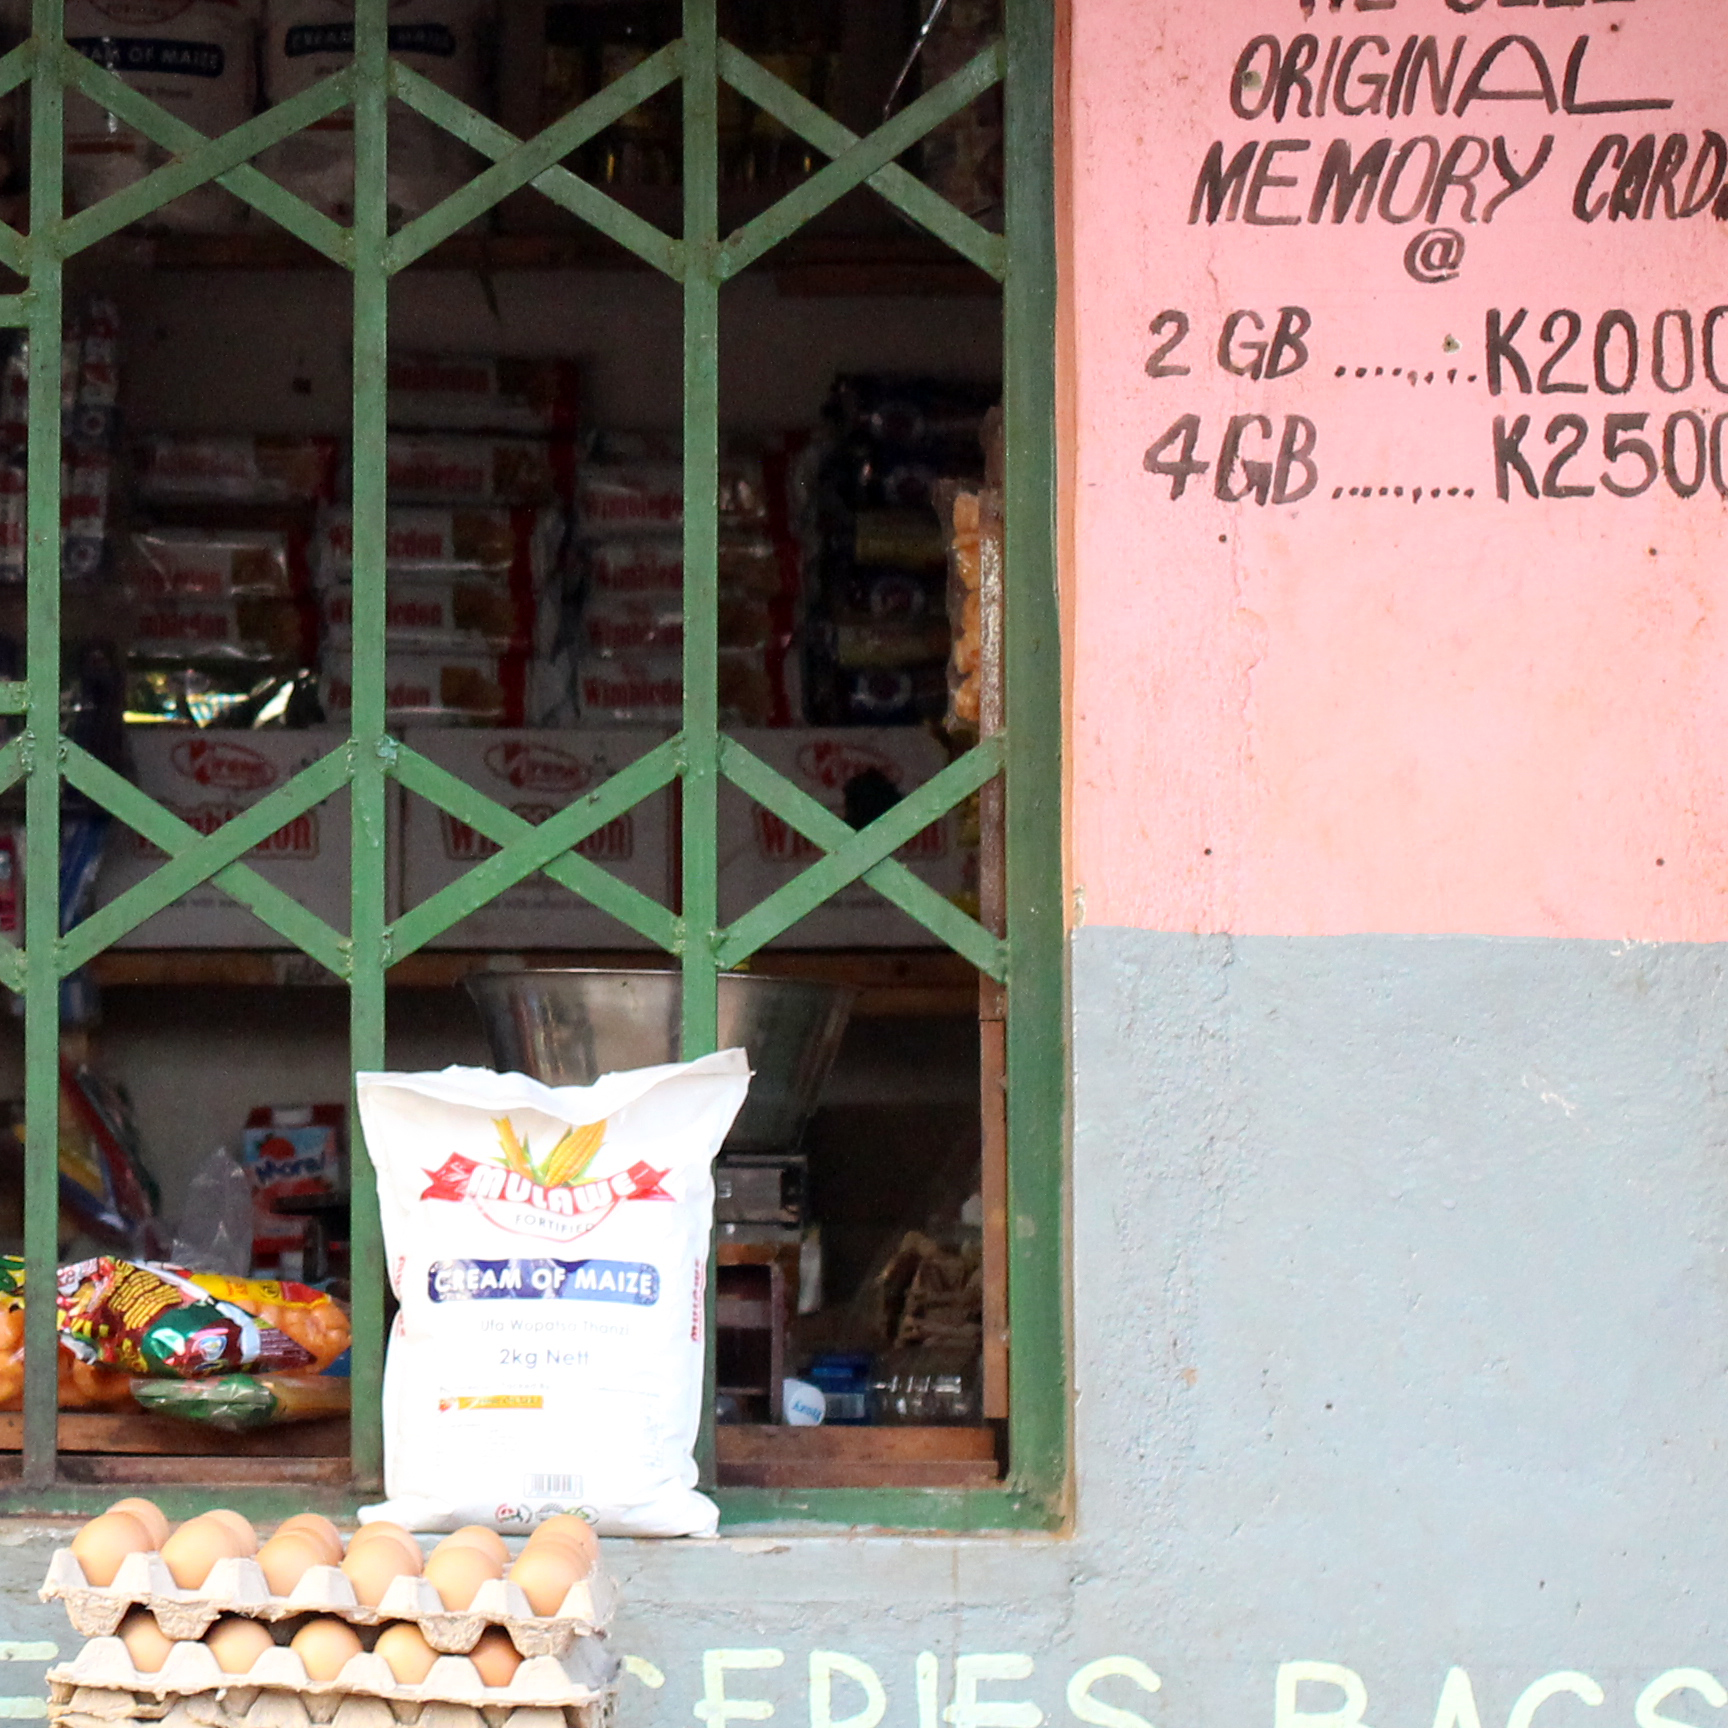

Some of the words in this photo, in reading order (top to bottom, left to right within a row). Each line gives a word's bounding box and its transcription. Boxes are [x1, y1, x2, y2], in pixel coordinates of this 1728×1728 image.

[1230, 34, 1674, 121] ORIGINAL
[1187, 134, 1554, 225] MEMORY
[466, 1164, 637, 1215] MULAWE
[514, 1213, 596, 1236] FORTIFIED
[432, 1264, 522, 1293] CREAM
[529, 1267, 567, 1290] OF
[574, 1269, 653, 1296] MAIZE
[498, 1347, 538, 1369] 2kg
[546, 1349, 590, 1366] Nett
